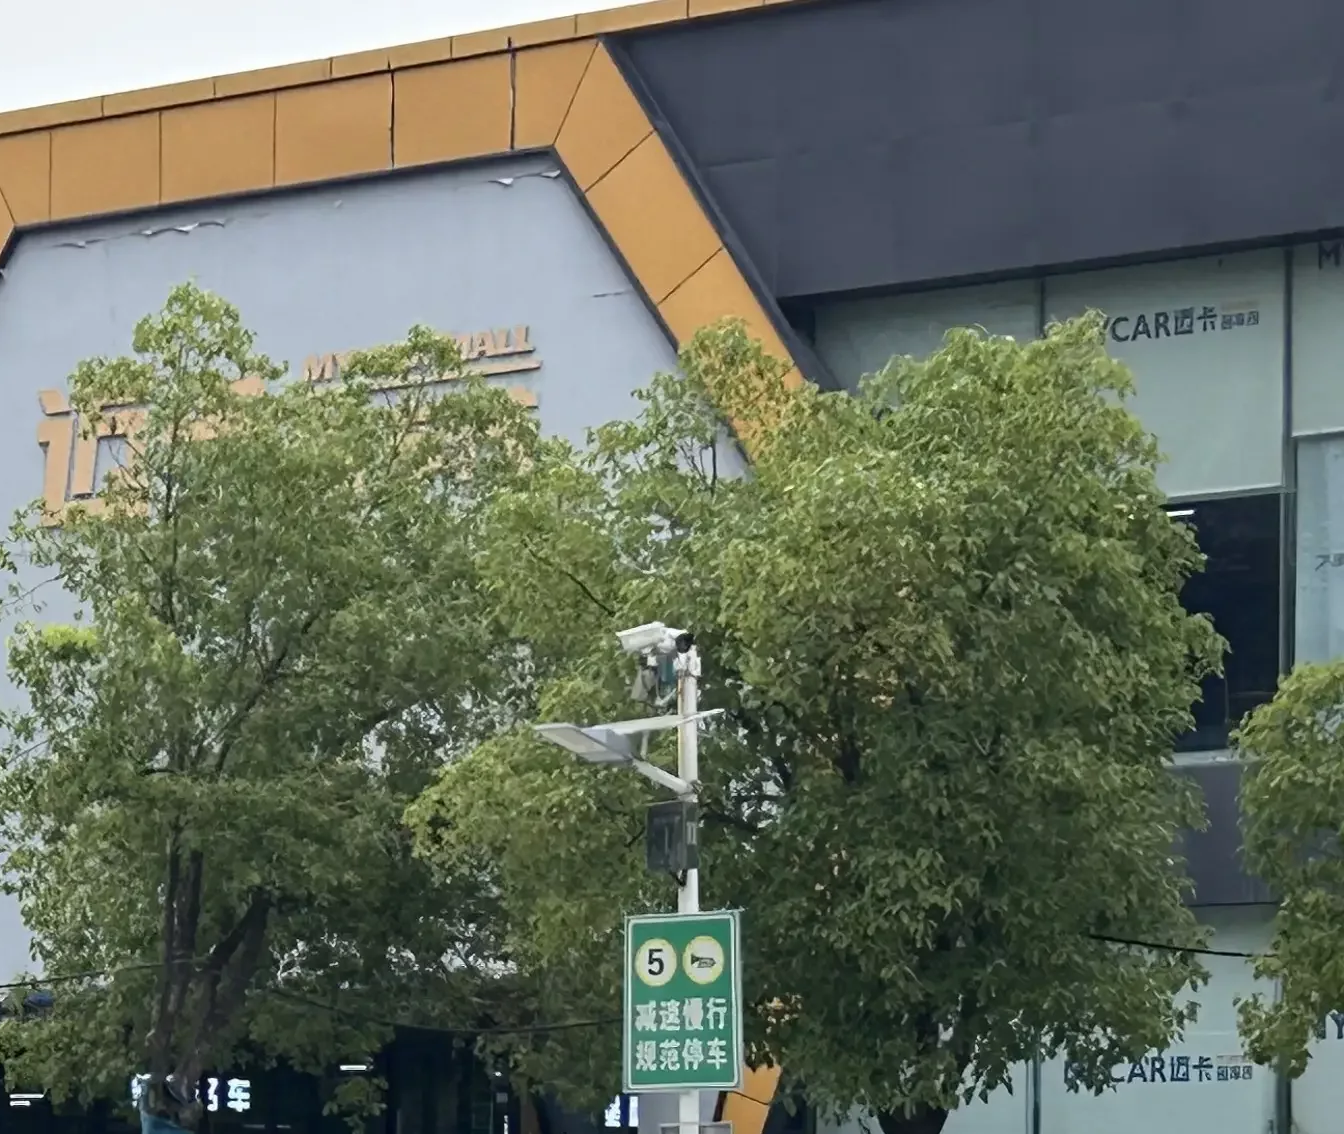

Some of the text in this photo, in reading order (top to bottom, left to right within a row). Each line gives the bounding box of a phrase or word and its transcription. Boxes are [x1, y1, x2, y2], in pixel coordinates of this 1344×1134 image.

[647, 948, 665, 976] 5
[634, 997, 728, 1032] 减速慢行
[635, 1036, 728, 1071] 规范停车
[1064, 1055, 1214, 1084] MCAR迈卡
